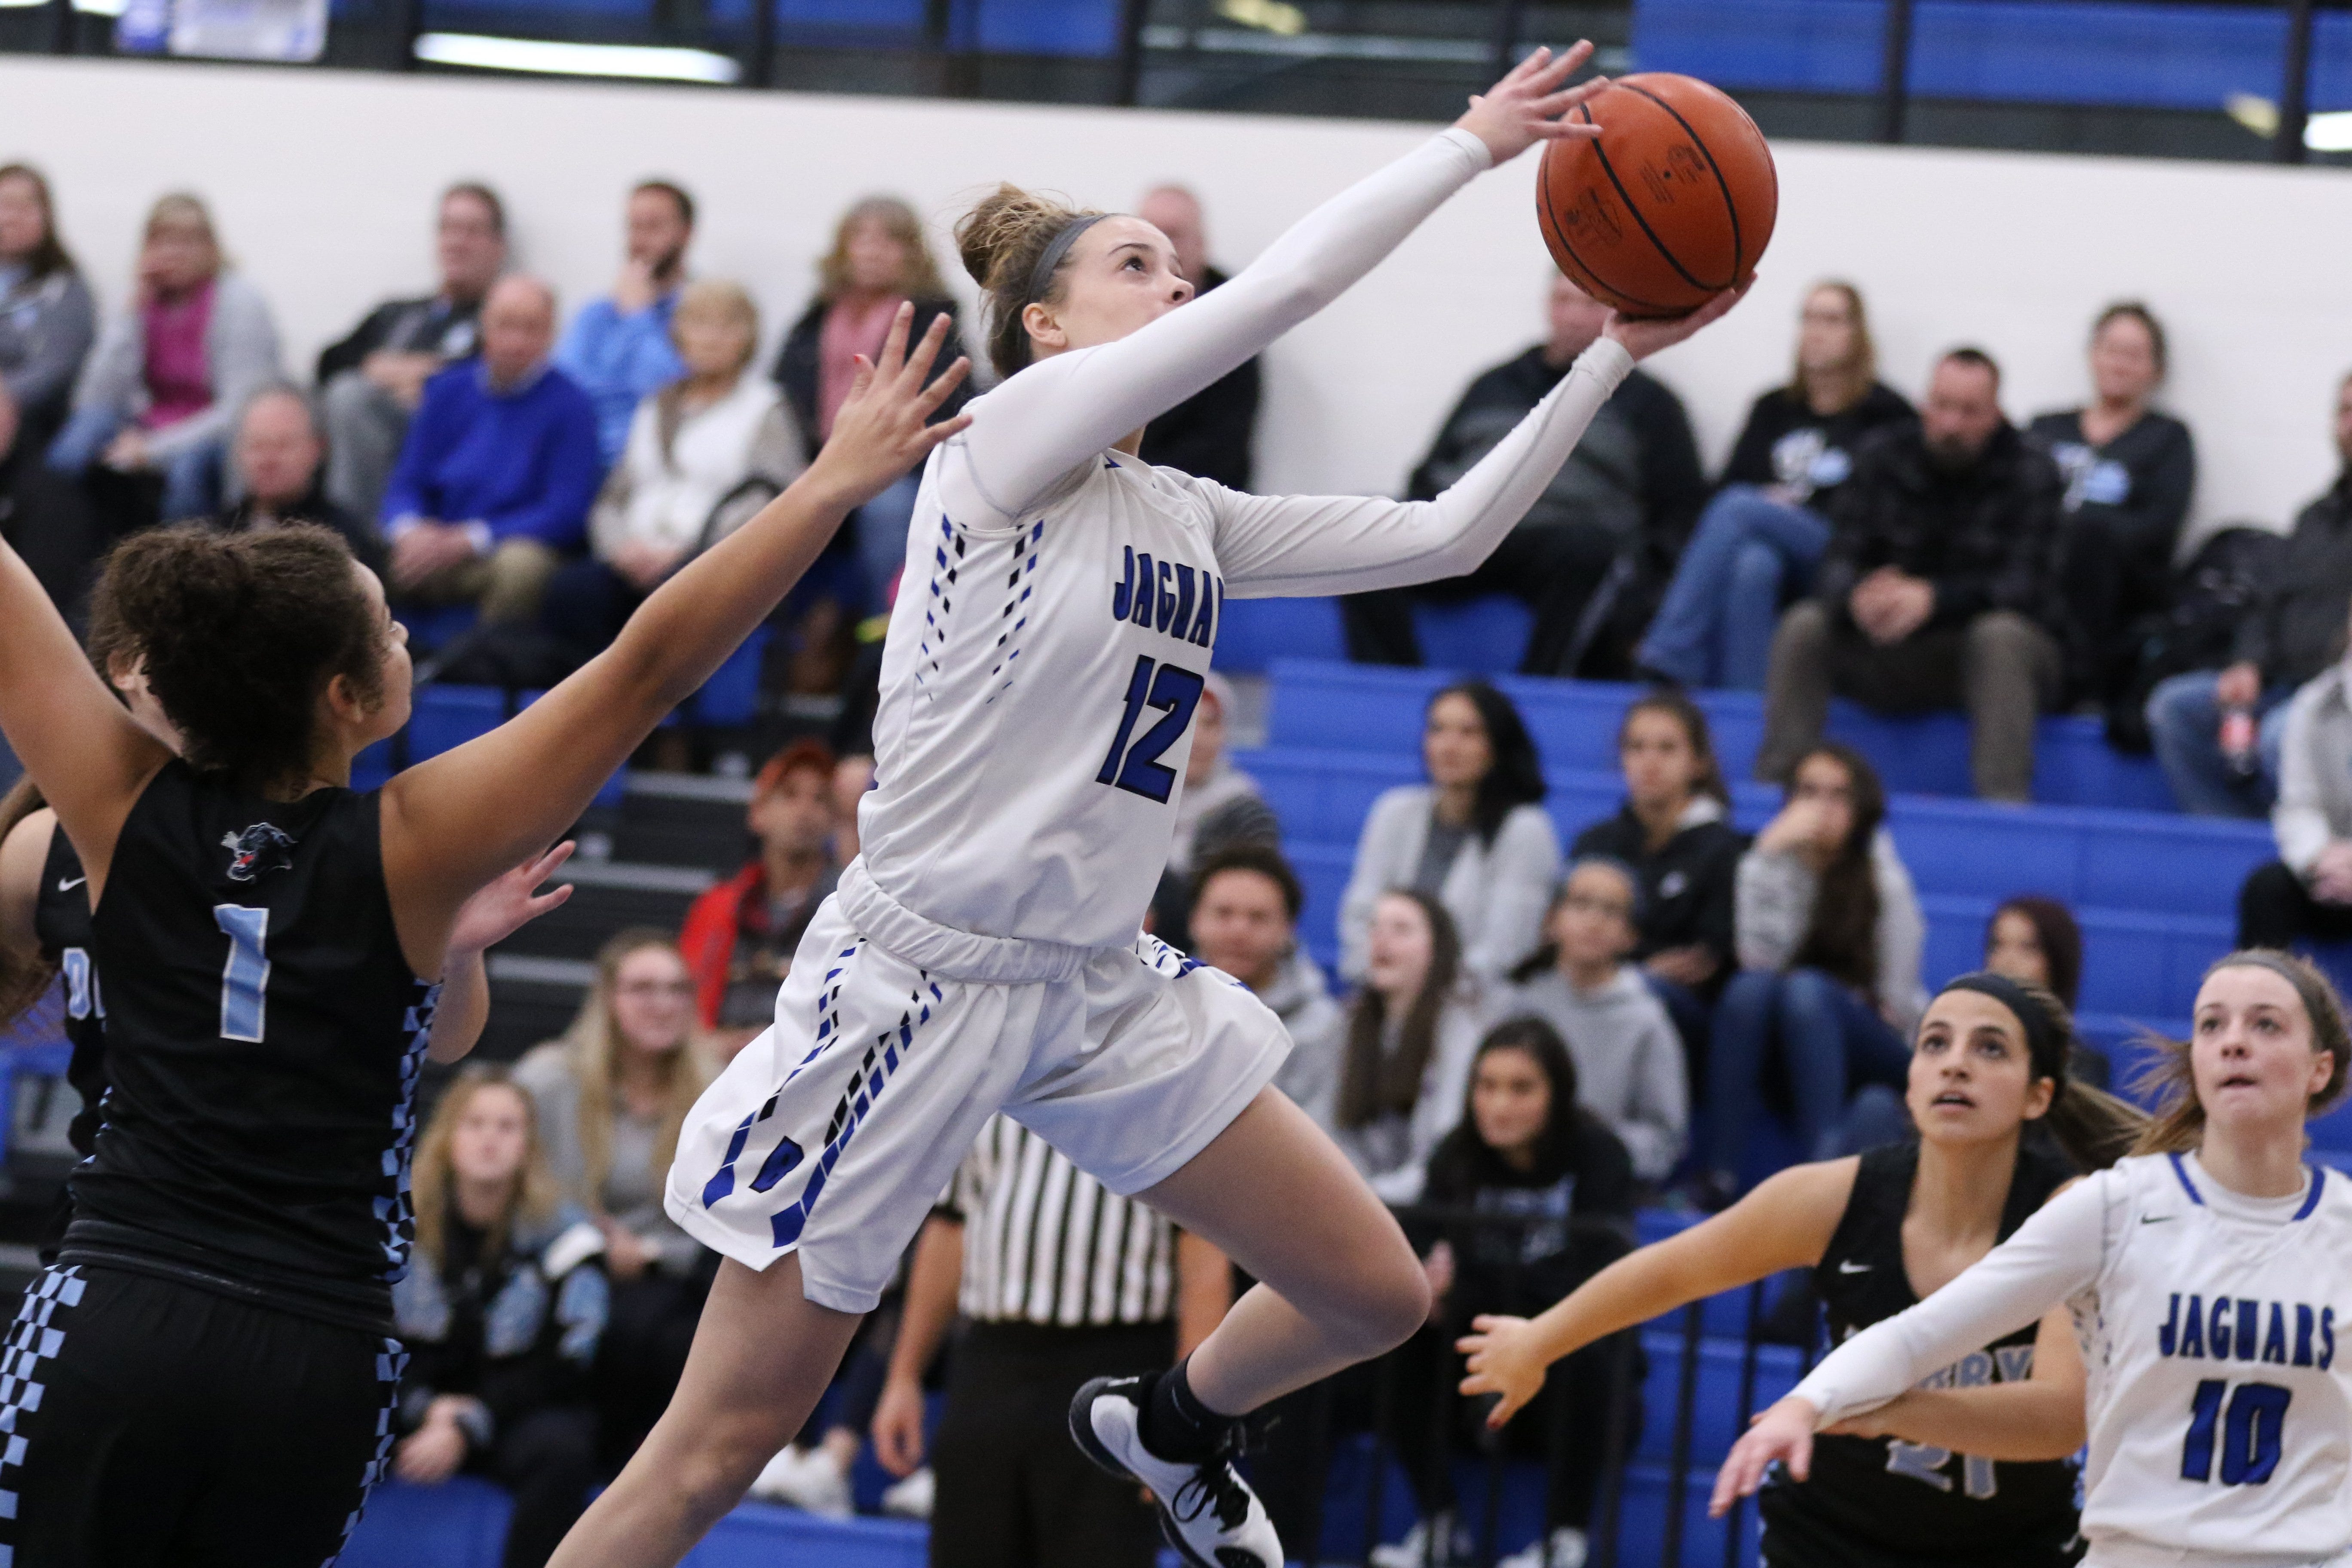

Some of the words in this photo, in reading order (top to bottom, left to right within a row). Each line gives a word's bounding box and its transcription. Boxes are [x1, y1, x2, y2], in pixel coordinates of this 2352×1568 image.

[1113, 544, 1224, 649] JAGUA
[1095, 654, 1205, 805] 12
[213, 903, 272, 1044] 1
[2159, 1293, 2336, 1371] JAGUARS
[2179, 1378, 2293, 1486] 10
